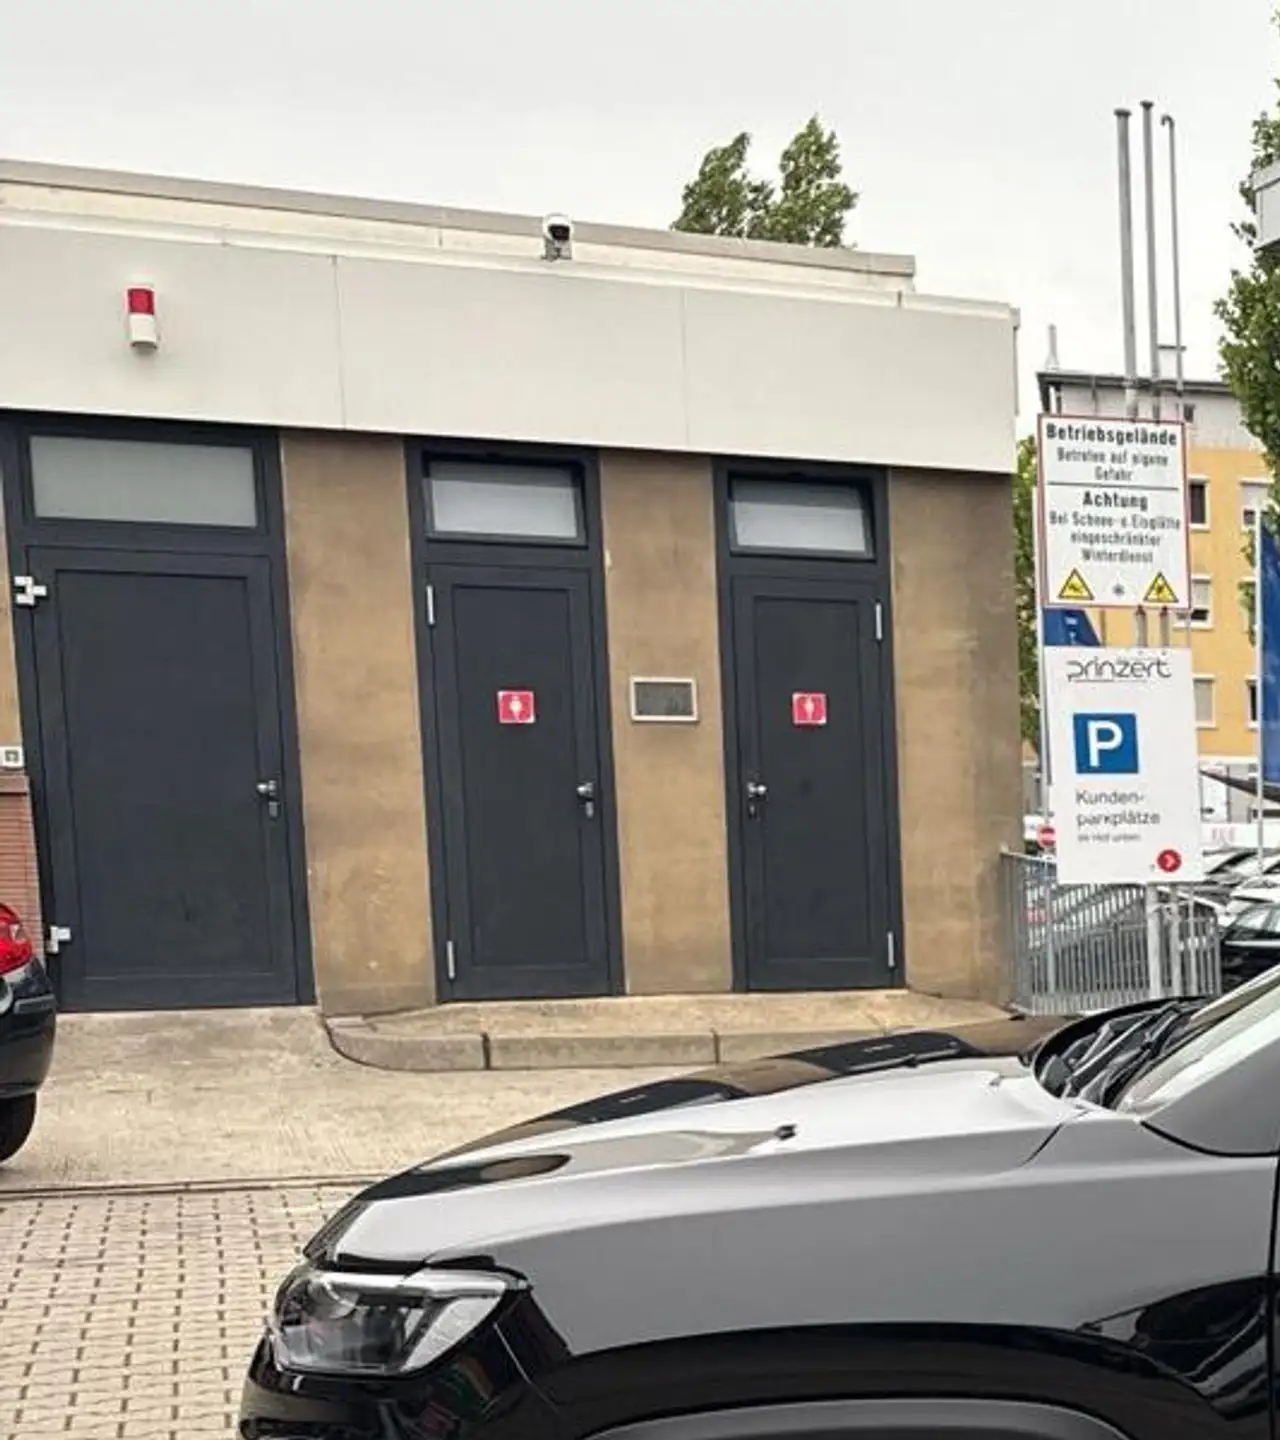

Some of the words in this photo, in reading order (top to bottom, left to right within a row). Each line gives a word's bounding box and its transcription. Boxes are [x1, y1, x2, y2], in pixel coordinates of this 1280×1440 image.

[1046, 423, 1177, 446] Betriebsgelände
[1082, 490, 1148, 511] Achtung
[1066, 656, 1172, 682] prinzert
[1087, 720, 1123, 767] P
[1076, 789, 1144, 805] Kunden-
[1077, 808, 1161, 827] parkplätze
